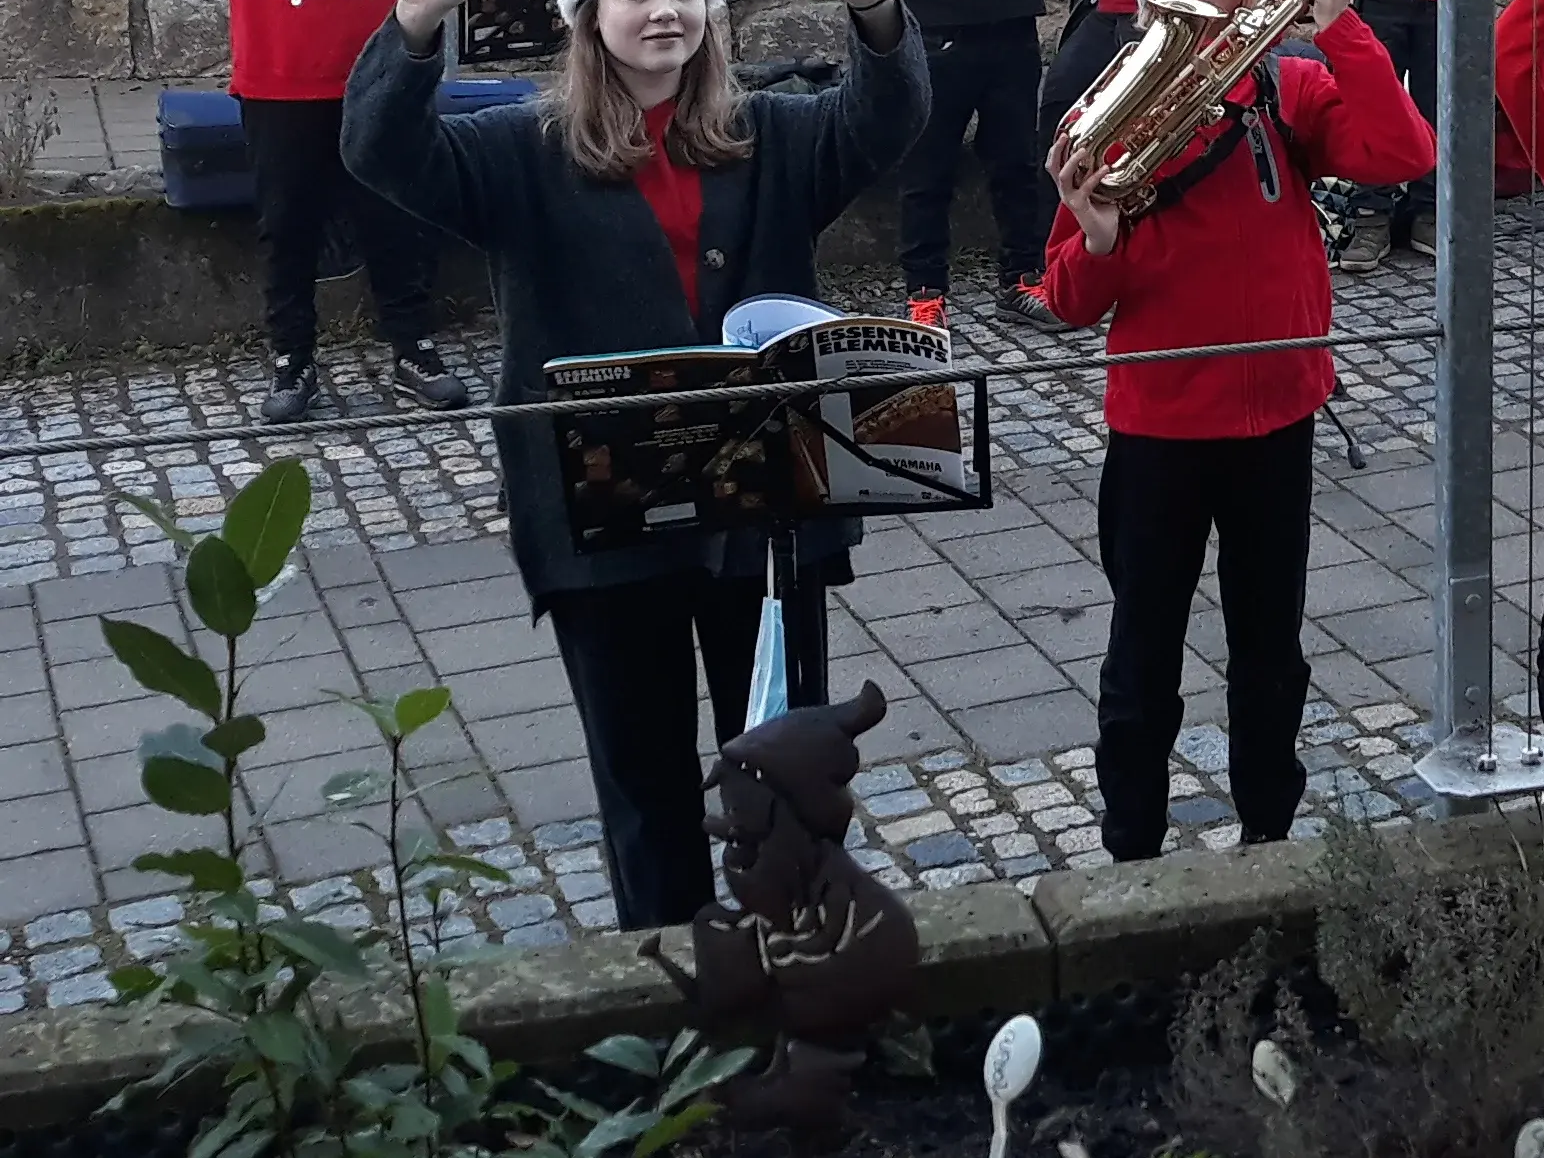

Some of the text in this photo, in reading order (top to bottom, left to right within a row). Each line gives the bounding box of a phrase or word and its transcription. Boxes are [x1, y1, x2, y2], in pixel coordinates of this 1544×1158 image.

[815, 326, 949, 353] ESSENTIAL
[819, 339, 949, 364] ELEMENTS
[893, 458, 943, 473] YAMAHA
